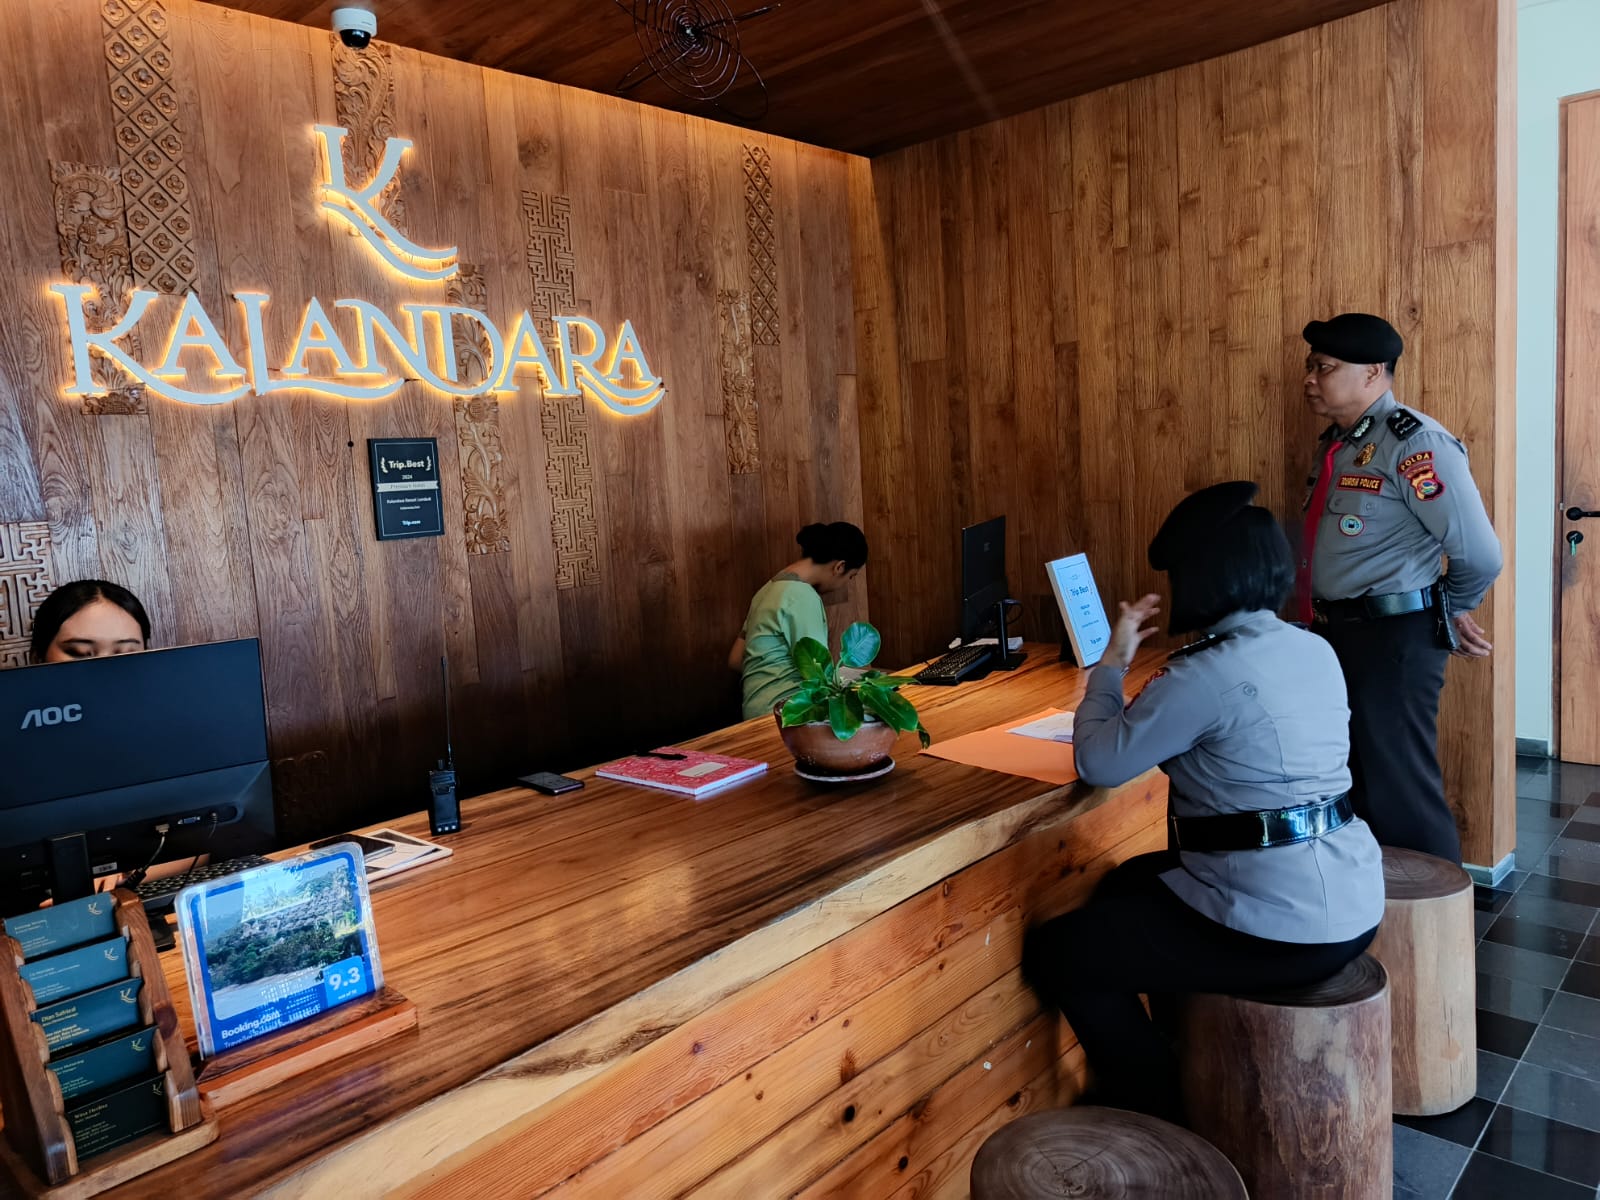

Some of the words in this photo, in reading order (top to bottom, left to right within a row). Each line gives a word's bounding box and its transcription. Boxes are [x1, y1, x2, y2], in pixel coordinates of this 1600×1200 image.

[314, 124, 458, 280] K
[50, 283, 666, 415] KALANDARA
[388, 460, 425, 470] Trip.Best
[1400, 453, 1430, 471] POLDA
[1360, 478, 1380, 489] POLICE
[20, 703, 82, 730] AOC
[328, 966, 361, 991] 9.3
[221, 1009, 281, 1040] Booking.com
